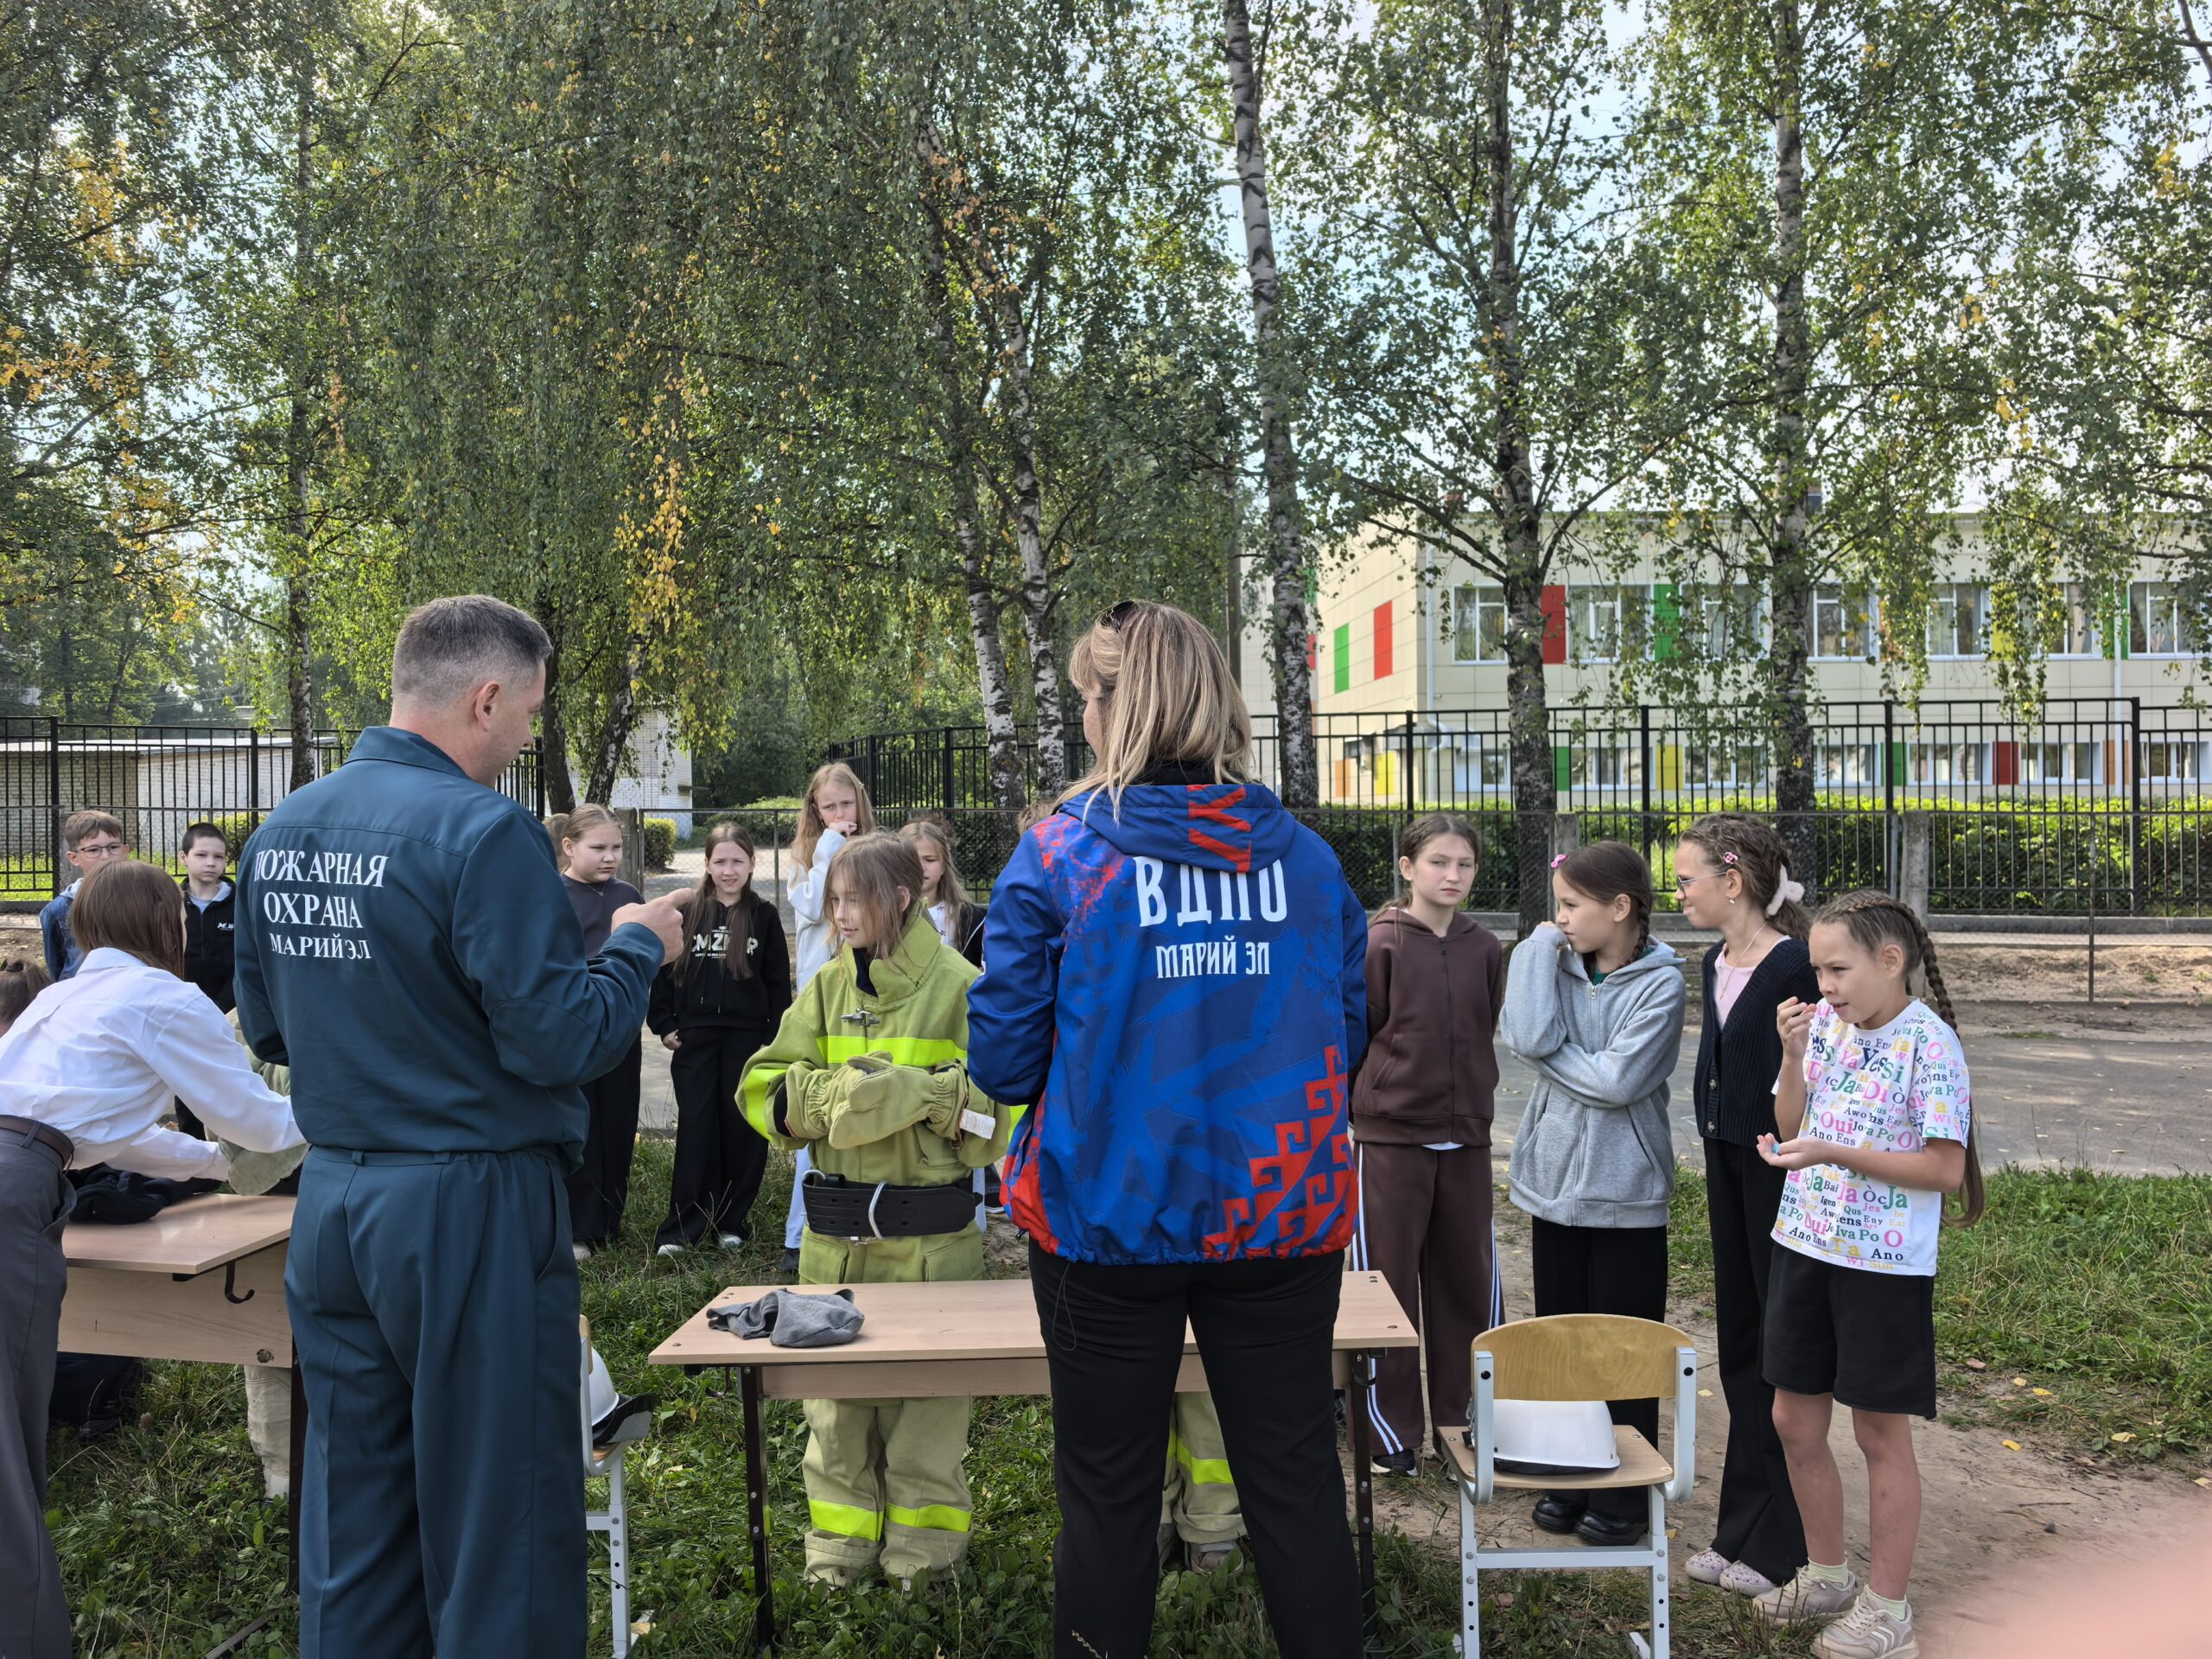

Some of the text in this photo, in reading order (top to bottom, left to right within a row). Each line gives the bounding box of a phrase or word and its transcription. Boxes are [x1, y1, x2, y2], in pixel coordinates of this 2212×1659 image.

[253, 849, 391, 887] ПОЖАРНАЯ
[1133, 855, 1287, 927] ВДПО
[264, 892, 363, 929] ОХРАНА
[1156, 935, 1270, 978] МАРИЙ ЭЛ
[1831, 1071, 1856, 1095] Ja
[1821, 1112, 1853, 1135] Oui
[1809, 1127, 1833, 1141] Ano
[1836, 1133, 1856, 1147] Ens
[1876, 1128, 1896, 1142] Po
[1883, 1185, 1908, 1210] Ja
[1844, 1205, 1862, 1216] Qus
[1864, 1215, 1884, 1224] Eny
[1789, 1227, 1811, 1242] Ano
[1835, 1225, 1856, 1240] Iva
[1859, 1230, 1879, 1242] Po
[1871, 1248, 1904, 1261] Ano
